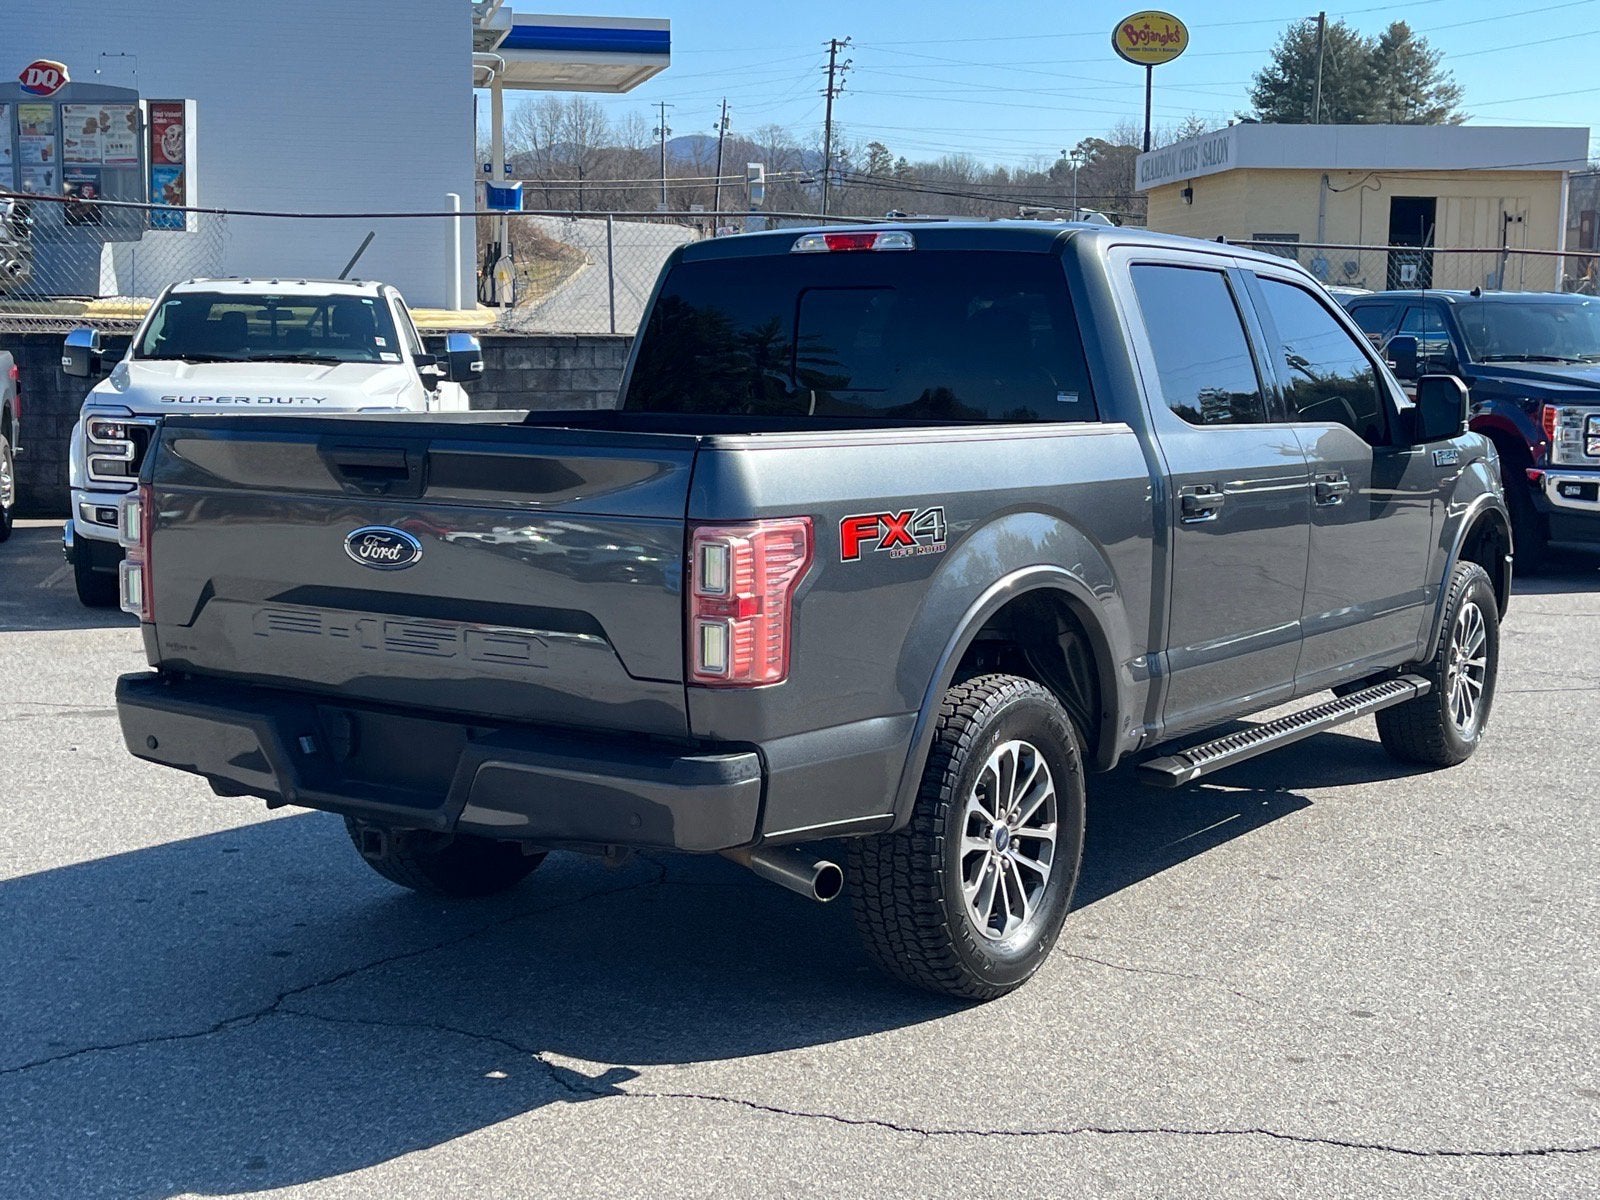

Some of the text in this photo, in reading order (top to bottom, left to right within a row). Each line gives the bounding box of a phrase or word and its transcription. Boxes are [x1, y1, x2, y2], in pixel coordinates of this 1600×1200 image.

[26, 68, 59, 89] DQ
[1141, 136, 1230, 183] CHAMPION CUTS SALON
[160, 395, 328, 405] SUPER DUTY
[359, 534, 404, 561] Ford
[839, 506, 948, 563] FX4
[889, 544, 948, 559] OFF ROAD
[252, 608, 550, 669] F-150
